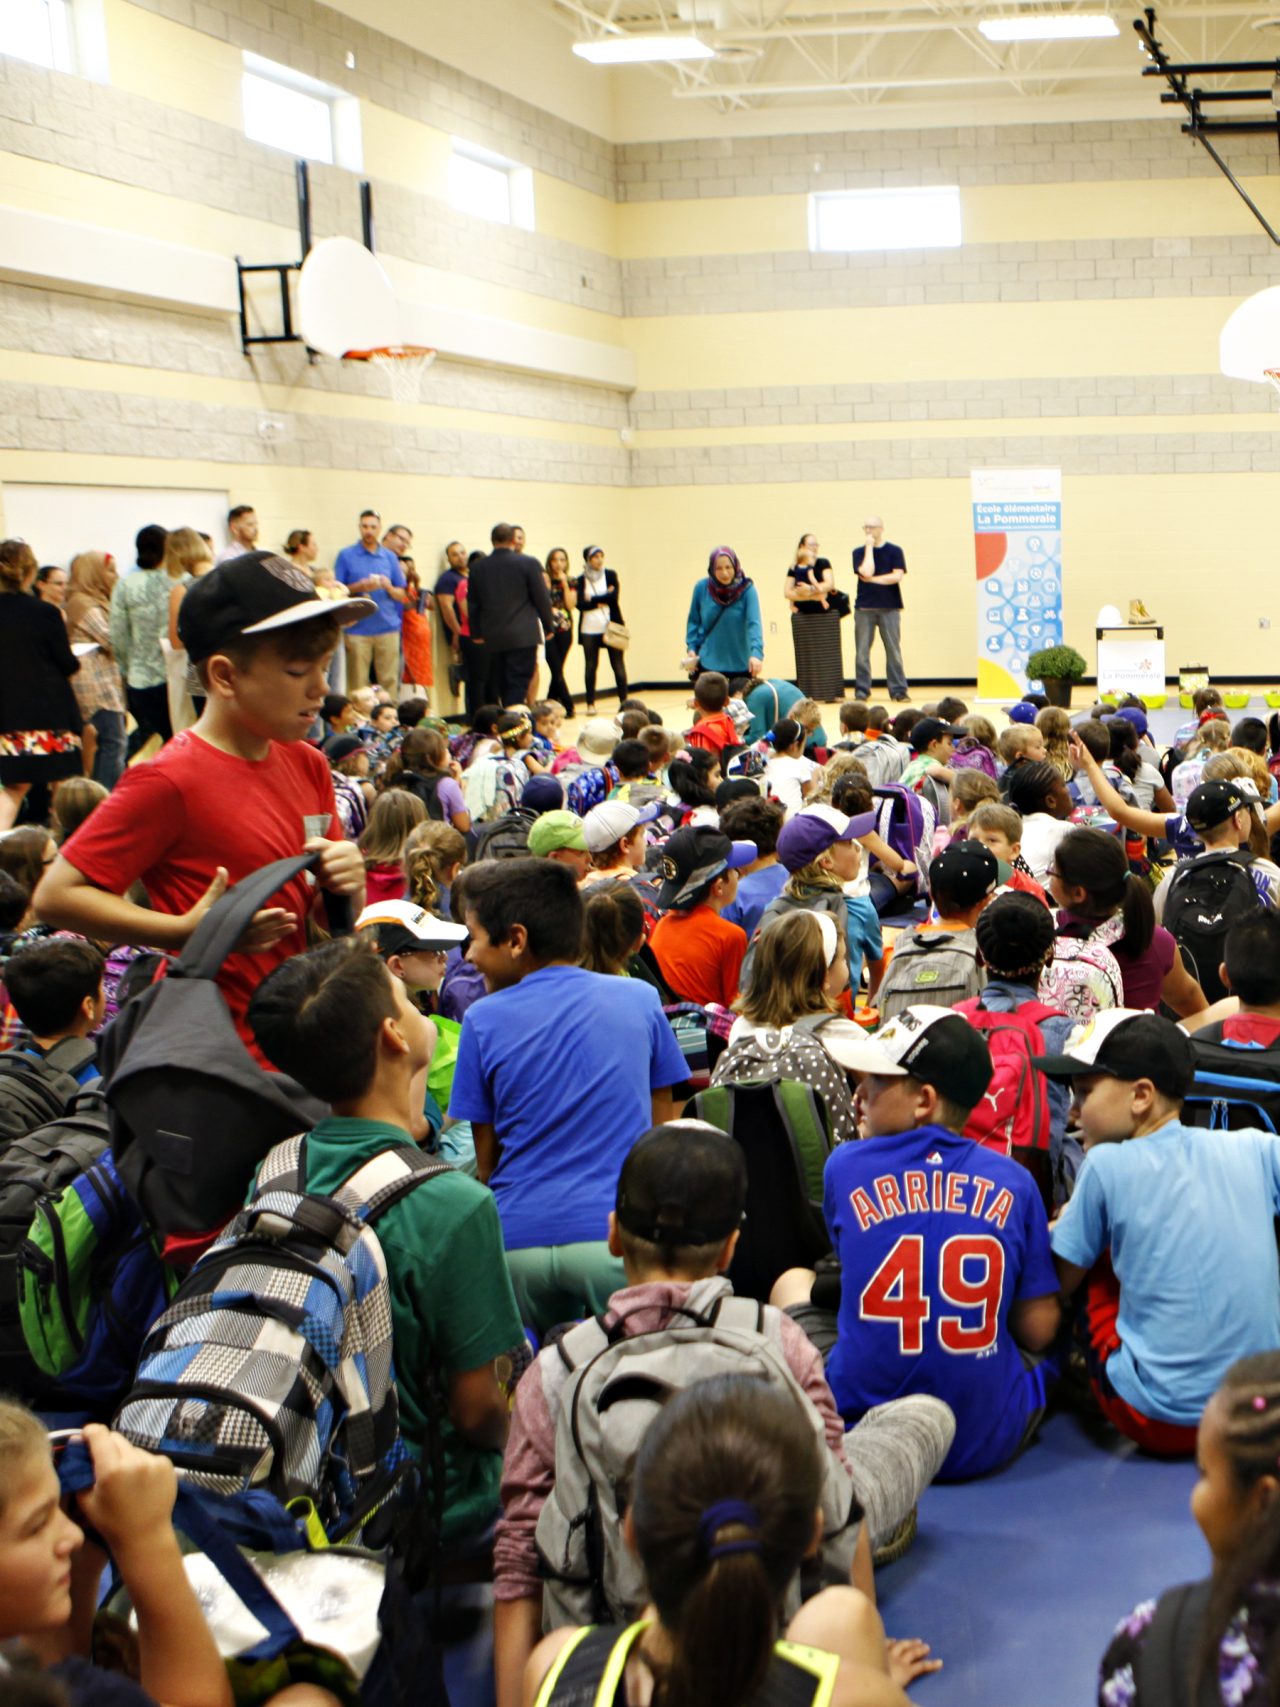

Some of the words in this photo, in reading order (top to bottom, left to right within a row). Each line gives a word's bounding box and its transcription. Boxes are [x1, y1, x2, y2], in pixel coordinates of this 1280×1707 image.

[977, 514, 991, 524] La
[850, 1170, 1014, 1232] ARRIETA
[859, 1234, 1005, 1354] 49
